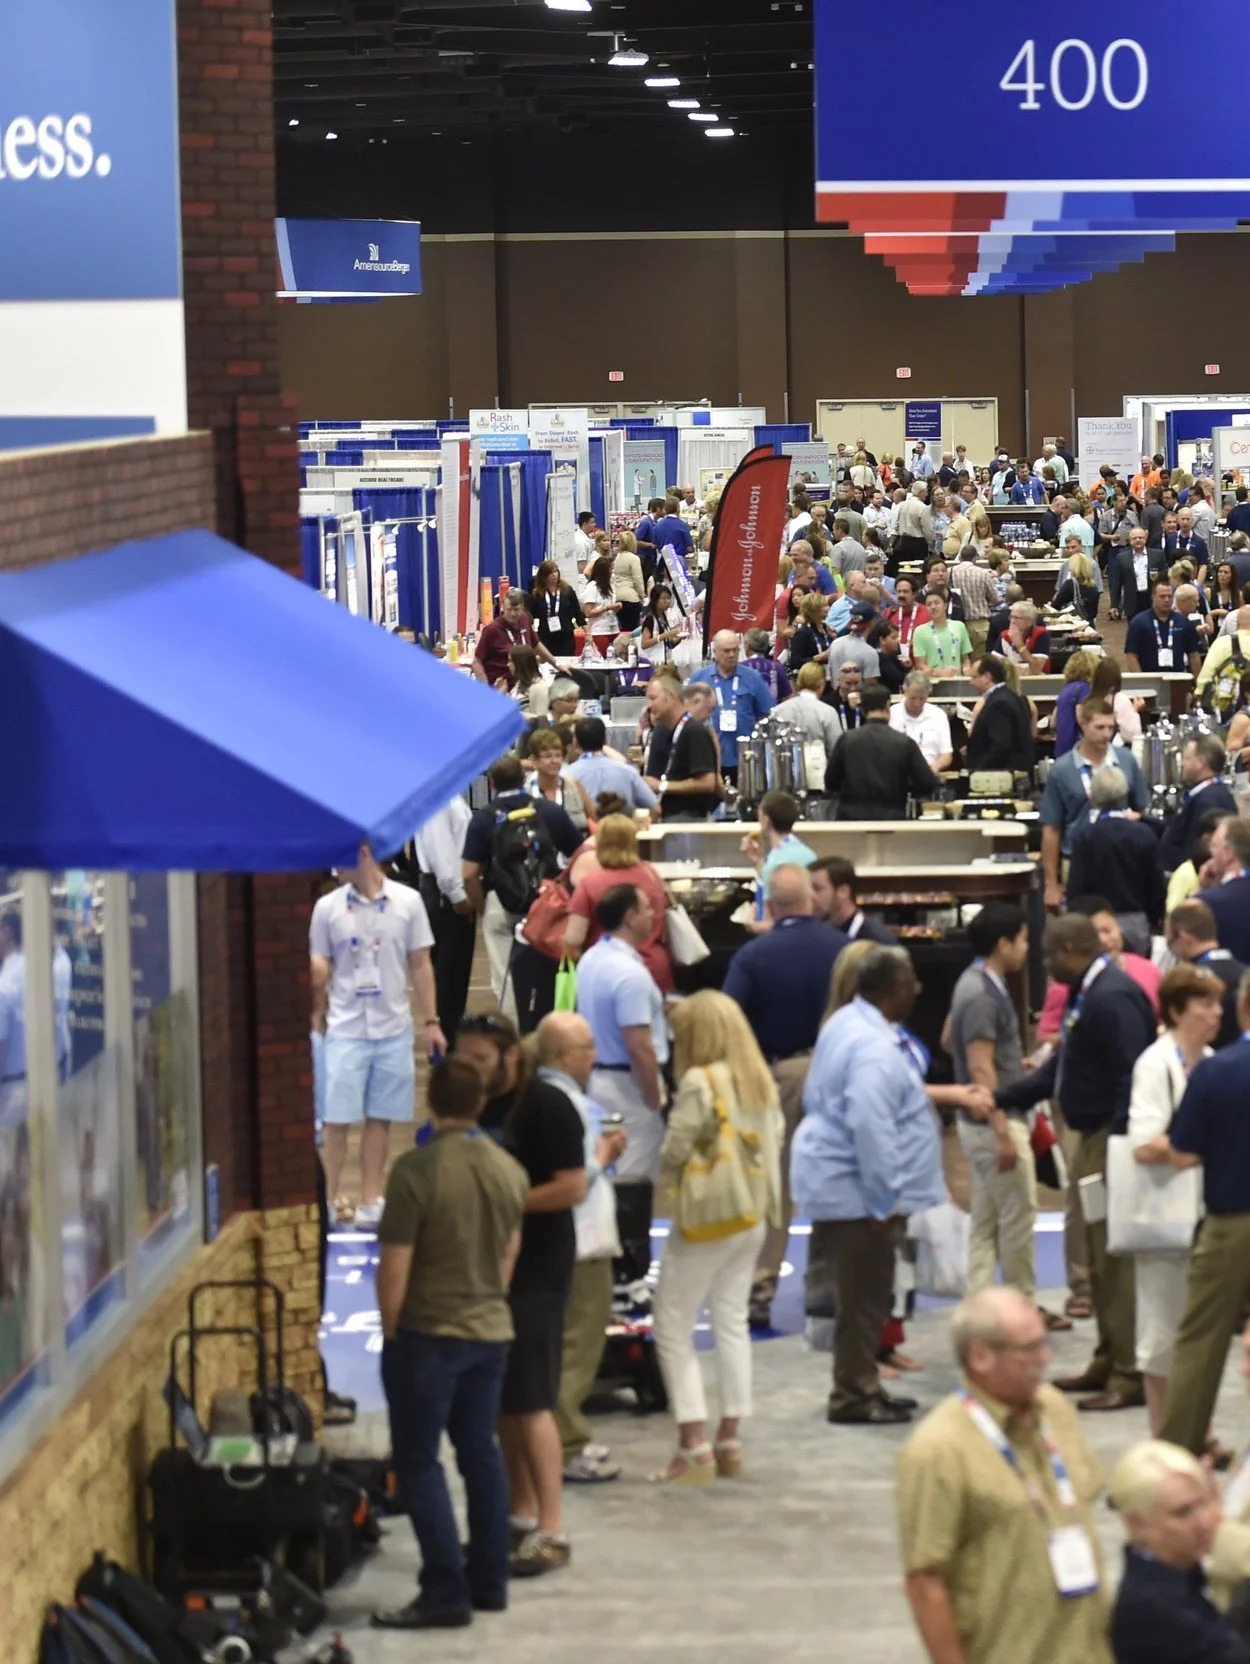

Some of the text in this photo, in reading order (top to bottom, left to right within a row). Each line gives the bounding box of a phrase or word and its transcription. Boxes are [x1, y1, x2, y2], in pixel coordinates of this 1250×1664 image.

[999, 38, 1148, 110] 400
[0, 112, 112, 181] ess.
[490, 412, 512, 422] Rash
[500, 422, 519, 432] Skin
[1085, 421, 1132, 430] Thank You
